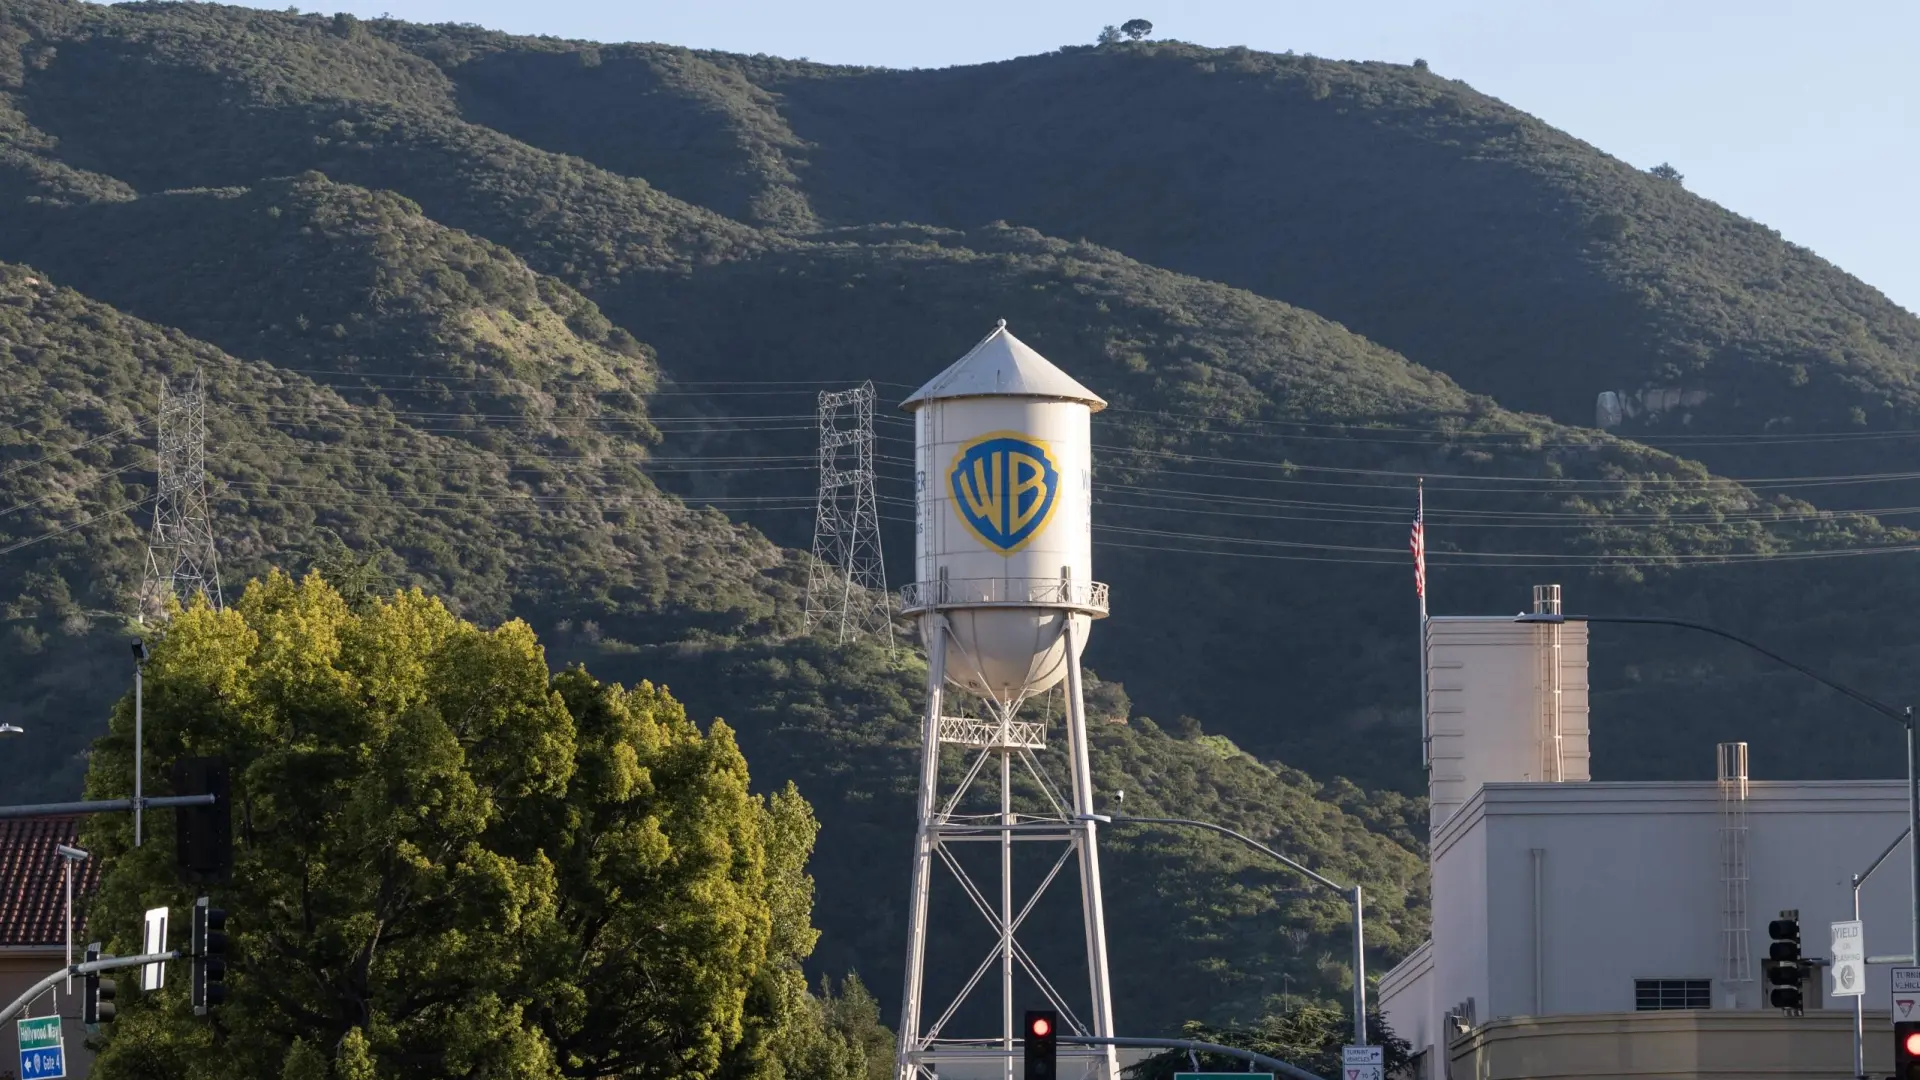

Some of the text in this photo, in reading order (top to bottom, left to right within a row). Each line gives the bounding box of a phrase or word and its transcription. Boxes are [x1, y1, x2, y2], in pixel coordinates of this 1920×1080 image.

[959, 451, 1048, 535] WB
[1834, 928, 1858, 938] YIELD
[20, 1023, 60, 1044] Hollywood Way
[43, 1055, 55, 1070] Gate
[56, 1054, 60, 1068] 4
